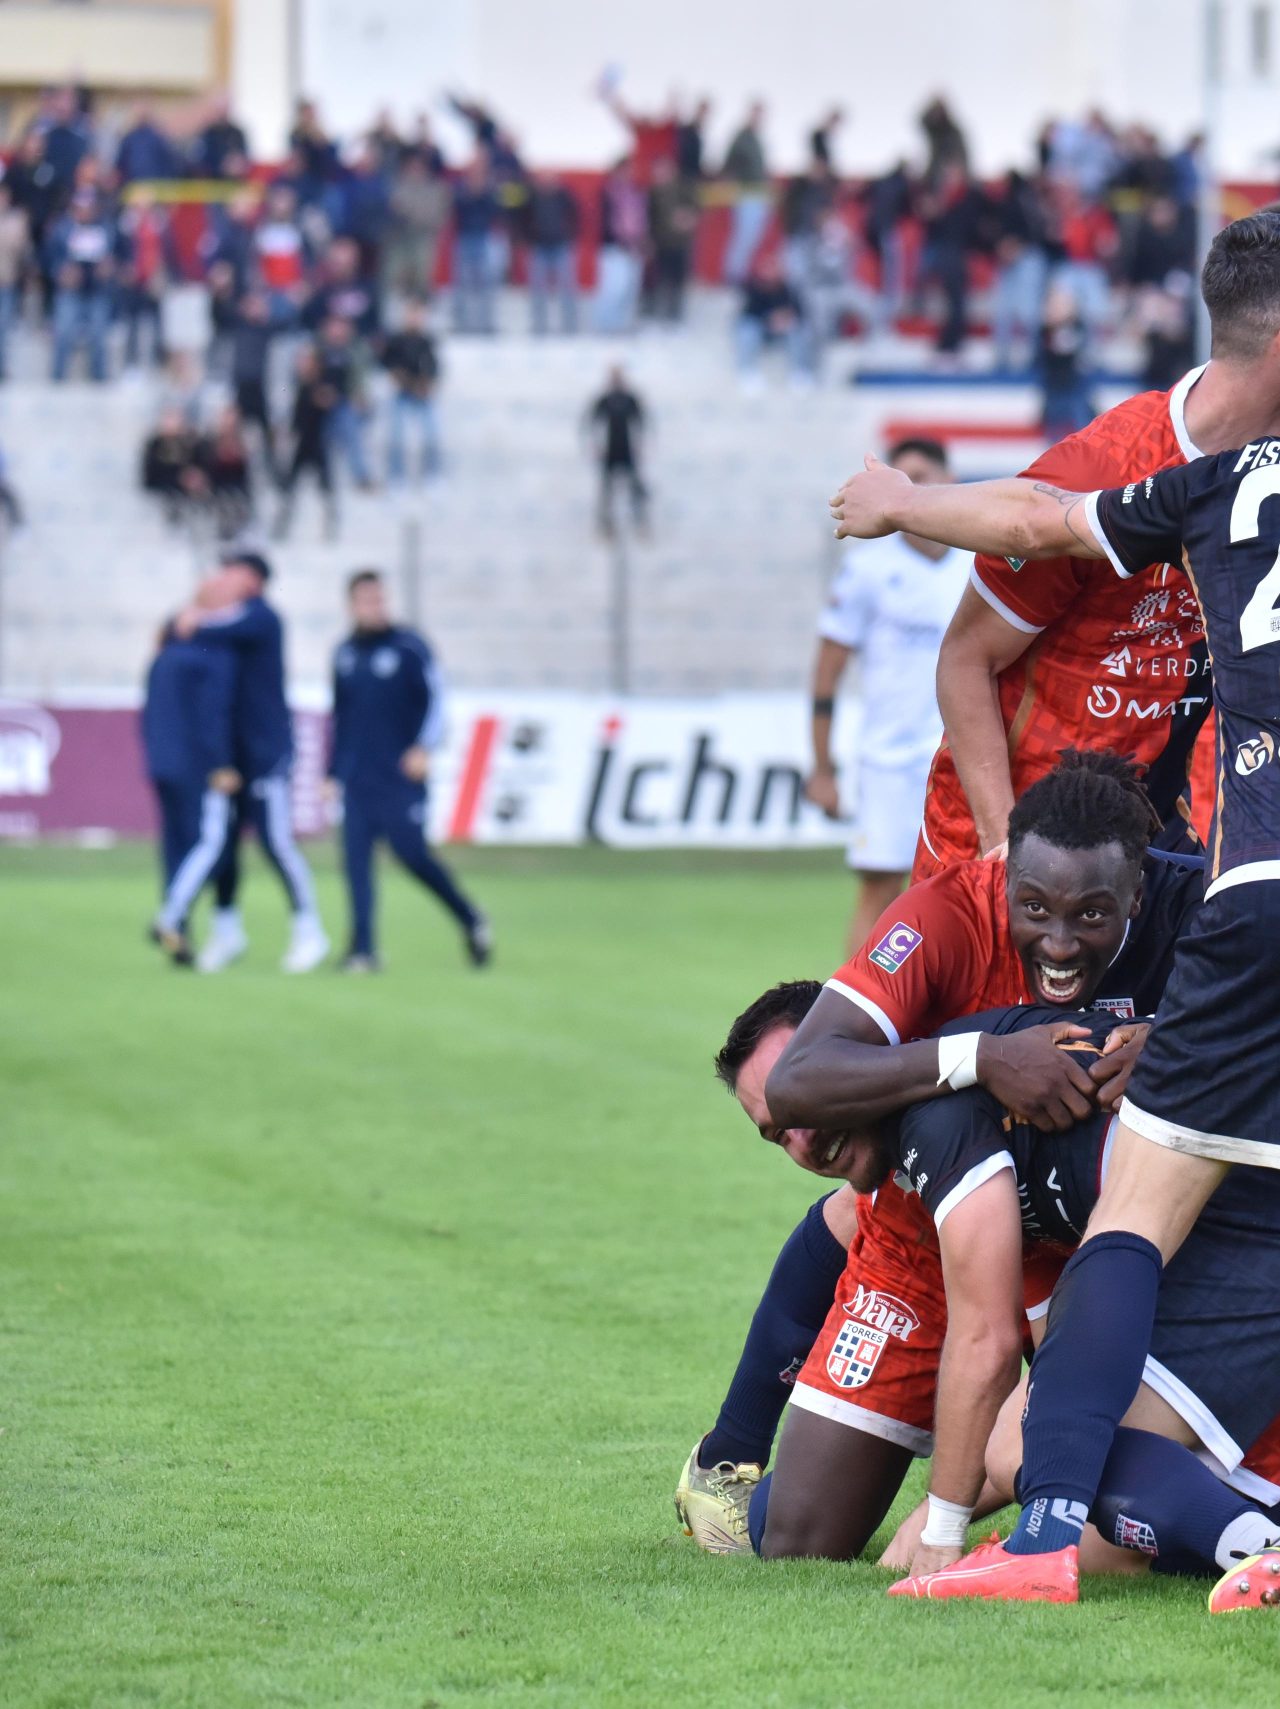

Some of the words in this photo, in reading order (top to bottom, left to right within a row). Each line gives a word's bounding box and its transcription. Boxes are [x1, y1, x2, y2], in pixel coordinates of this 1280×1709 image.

[1093, 1000, 1131, 1008] ORRES
[843, 1283, 914, 1342] Mara
[846, 1322, 885, 1344] TORRES
